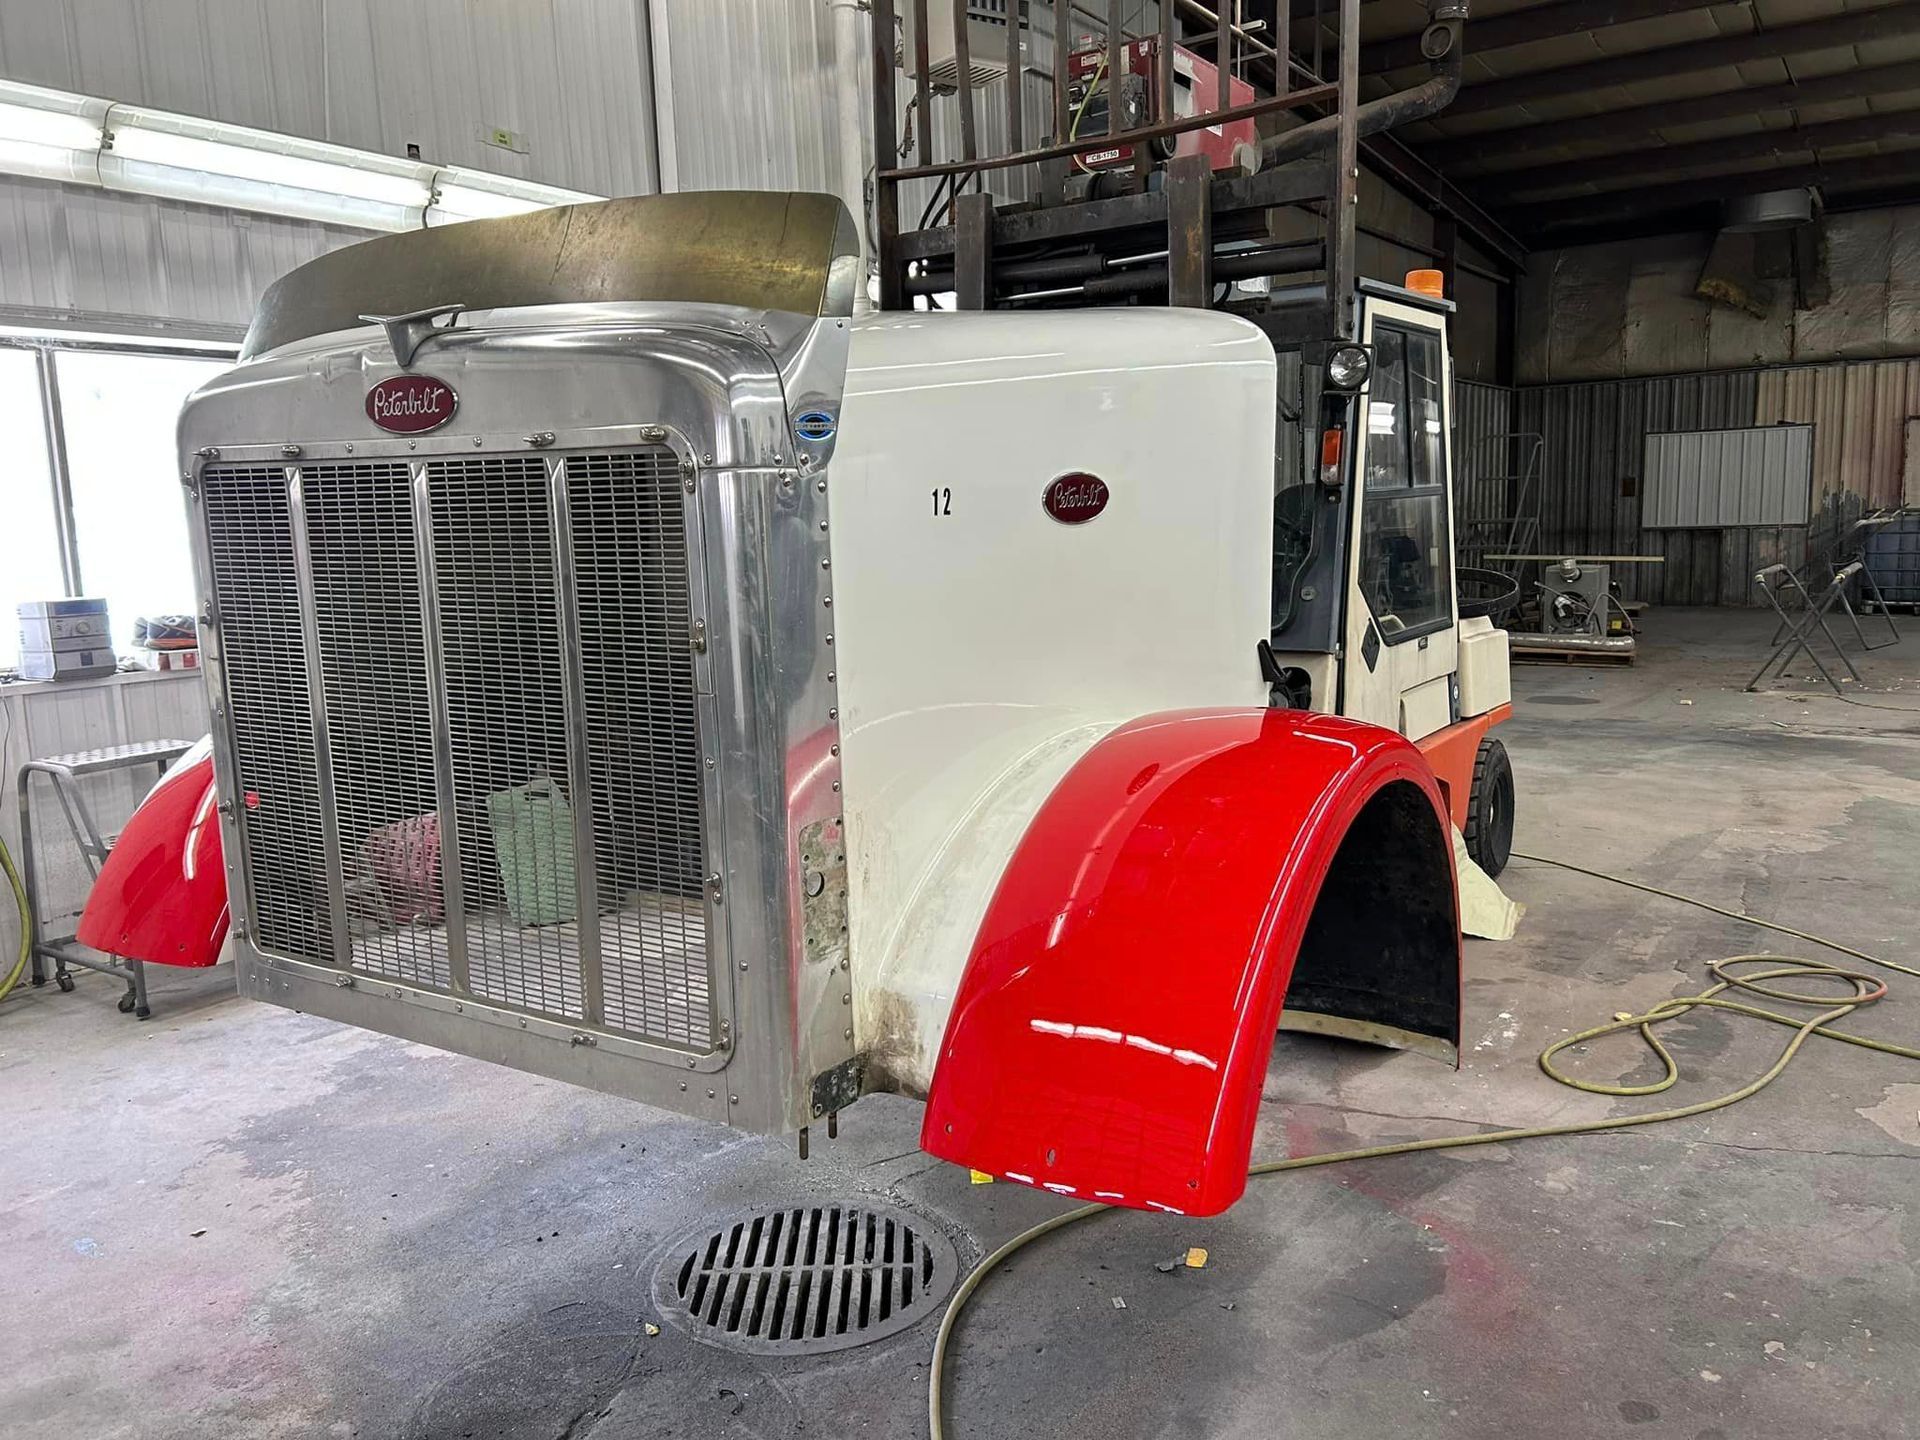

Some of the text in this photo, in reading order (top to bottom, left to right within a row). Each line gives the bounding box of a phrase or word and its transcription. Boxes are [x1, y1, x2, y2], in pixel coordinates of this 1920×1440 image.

[374, 387, 445, 421] Peterbilt
[931, 487, 951, 516] 12
[1053, 482, 1105, 512] Peterbilt
